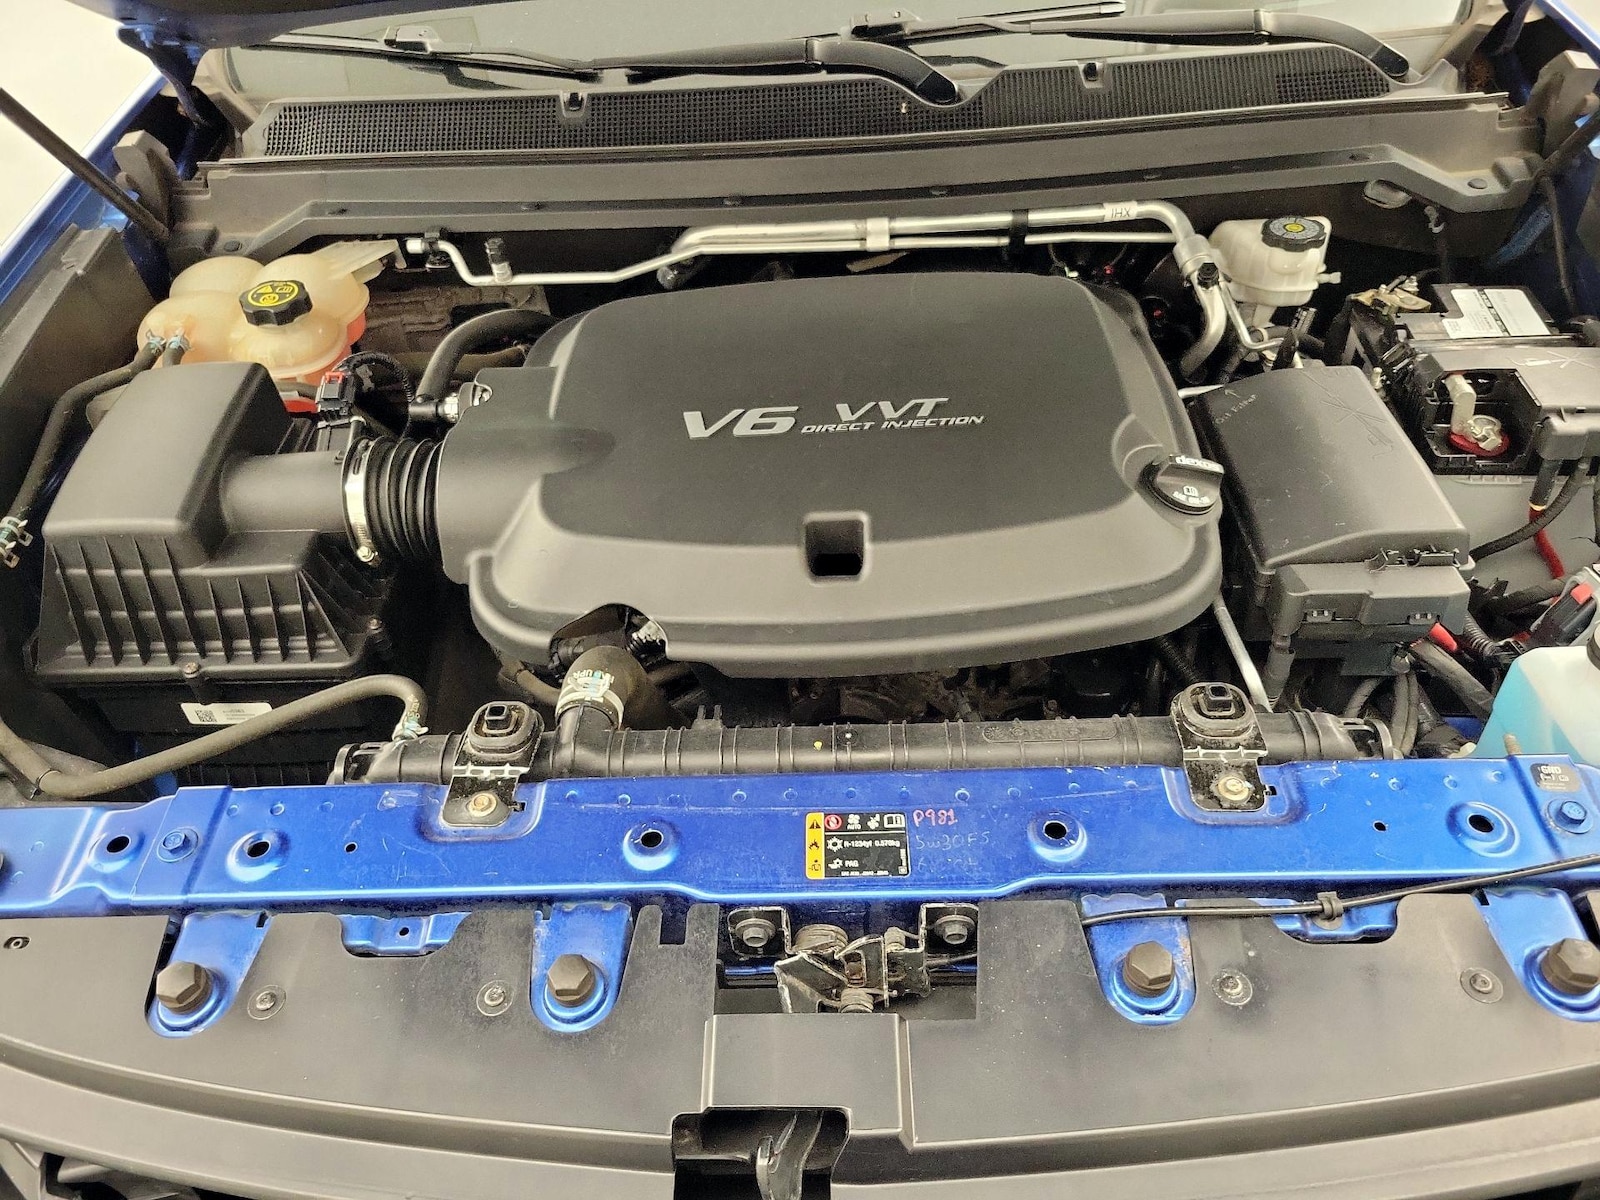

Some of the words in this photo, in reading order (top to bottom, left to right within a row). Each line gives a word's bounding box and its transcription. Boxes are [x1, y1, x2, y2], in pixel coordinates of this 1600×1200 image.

[1111, 207, 1131, 218] IHX
[683, 406, 799, 440] V6
[835, 397, 949, 422] VVT
[800, 421, 876, 434] DIRECT
[880, 415, 985, 430] INJECTION
